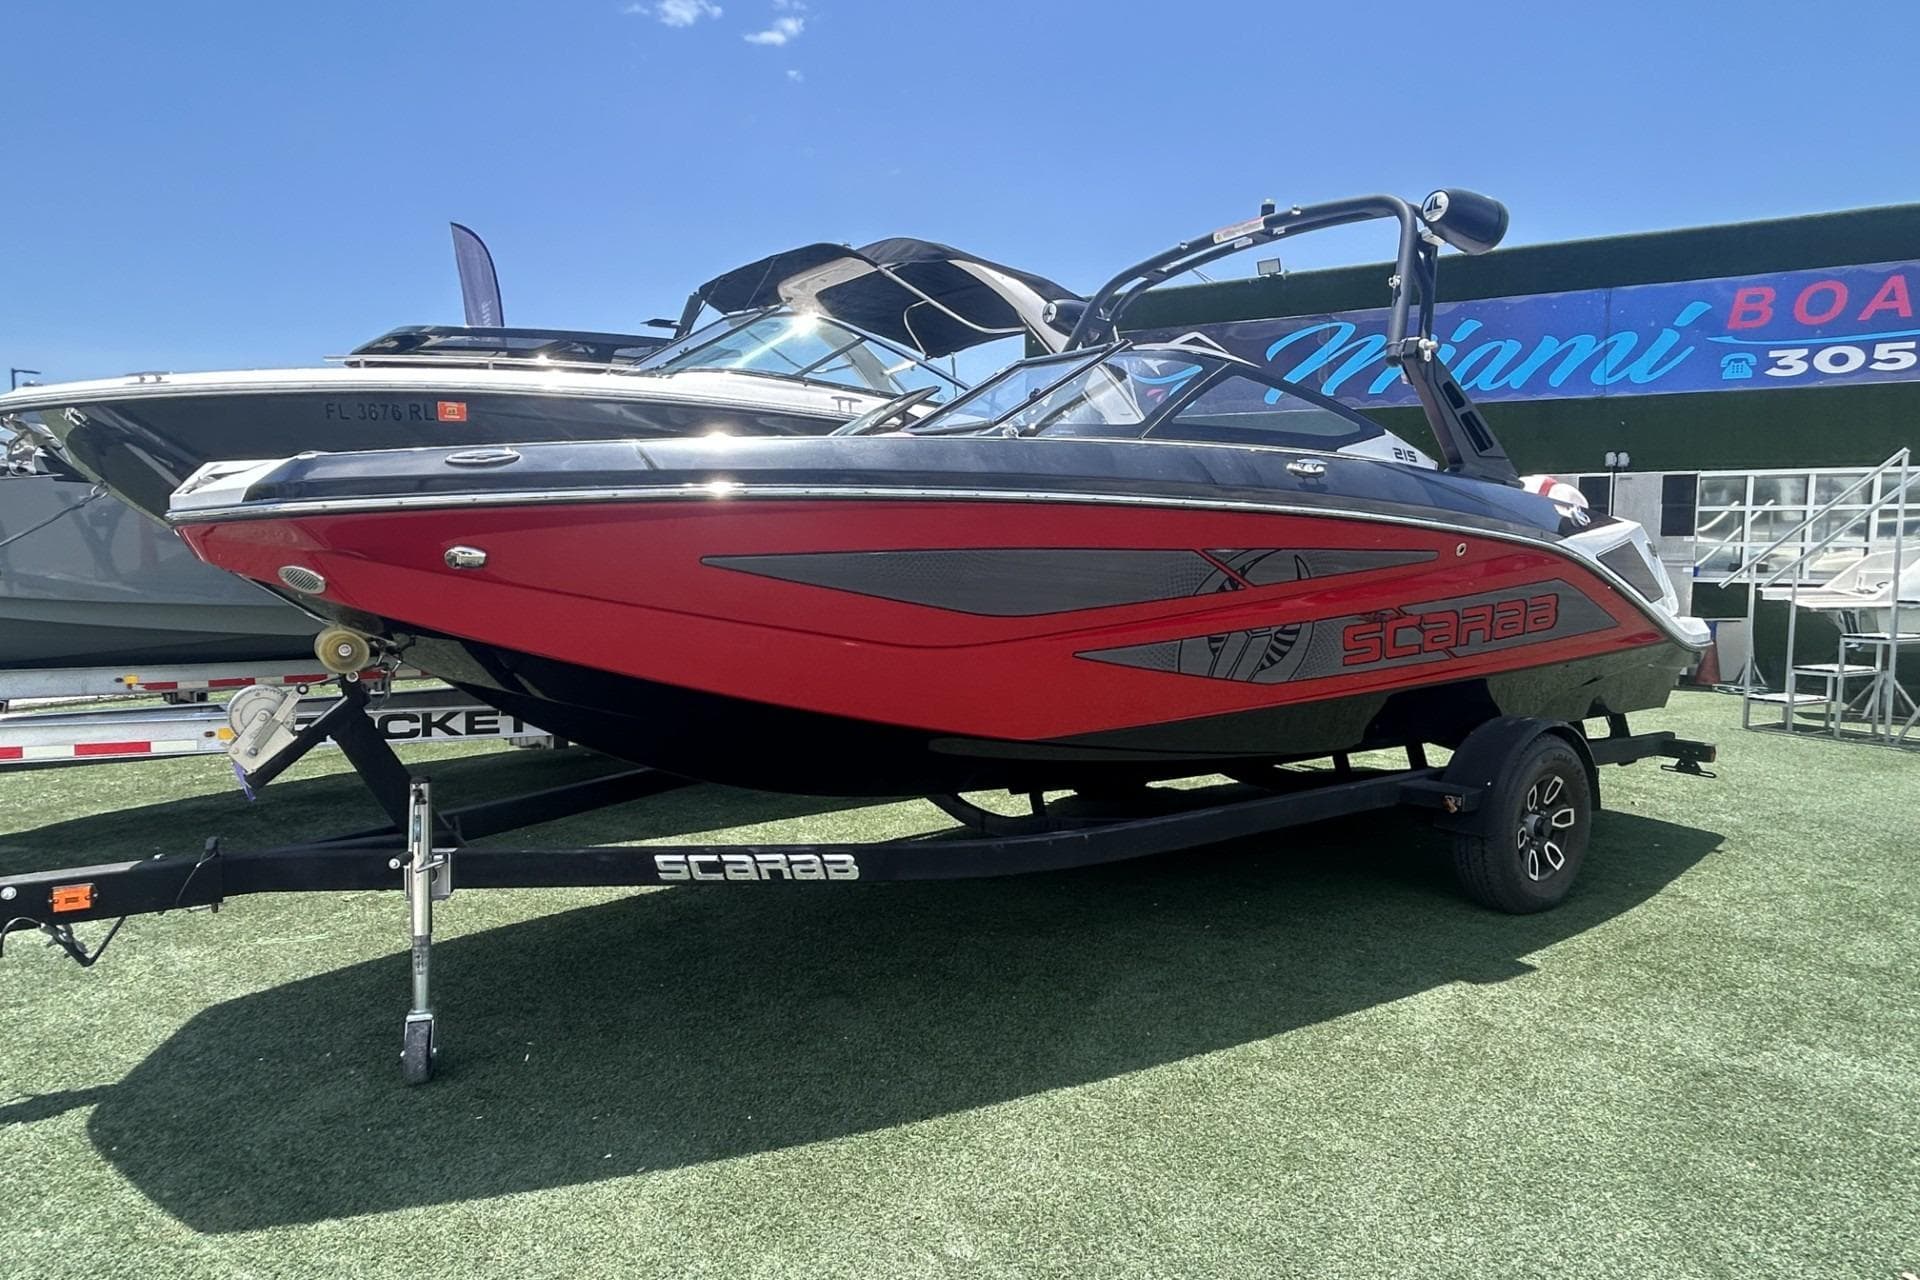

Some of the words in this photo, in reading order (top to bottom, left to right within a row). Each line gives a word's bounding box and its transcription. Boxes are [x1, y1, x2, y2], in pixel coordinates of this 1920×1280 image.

[1727, 274, 1913, 330] BOA
[1264, 301, 1712, 405] Miami
[1764, 341, 1918, 377] 305
[325, 403, 350, 420] FL
[357, 402, 403, 422] 3676
[408, 403, 435, 421] RL
[1392, 447, 1418, 463] 215
[296, 710, 524, 740] CKET
